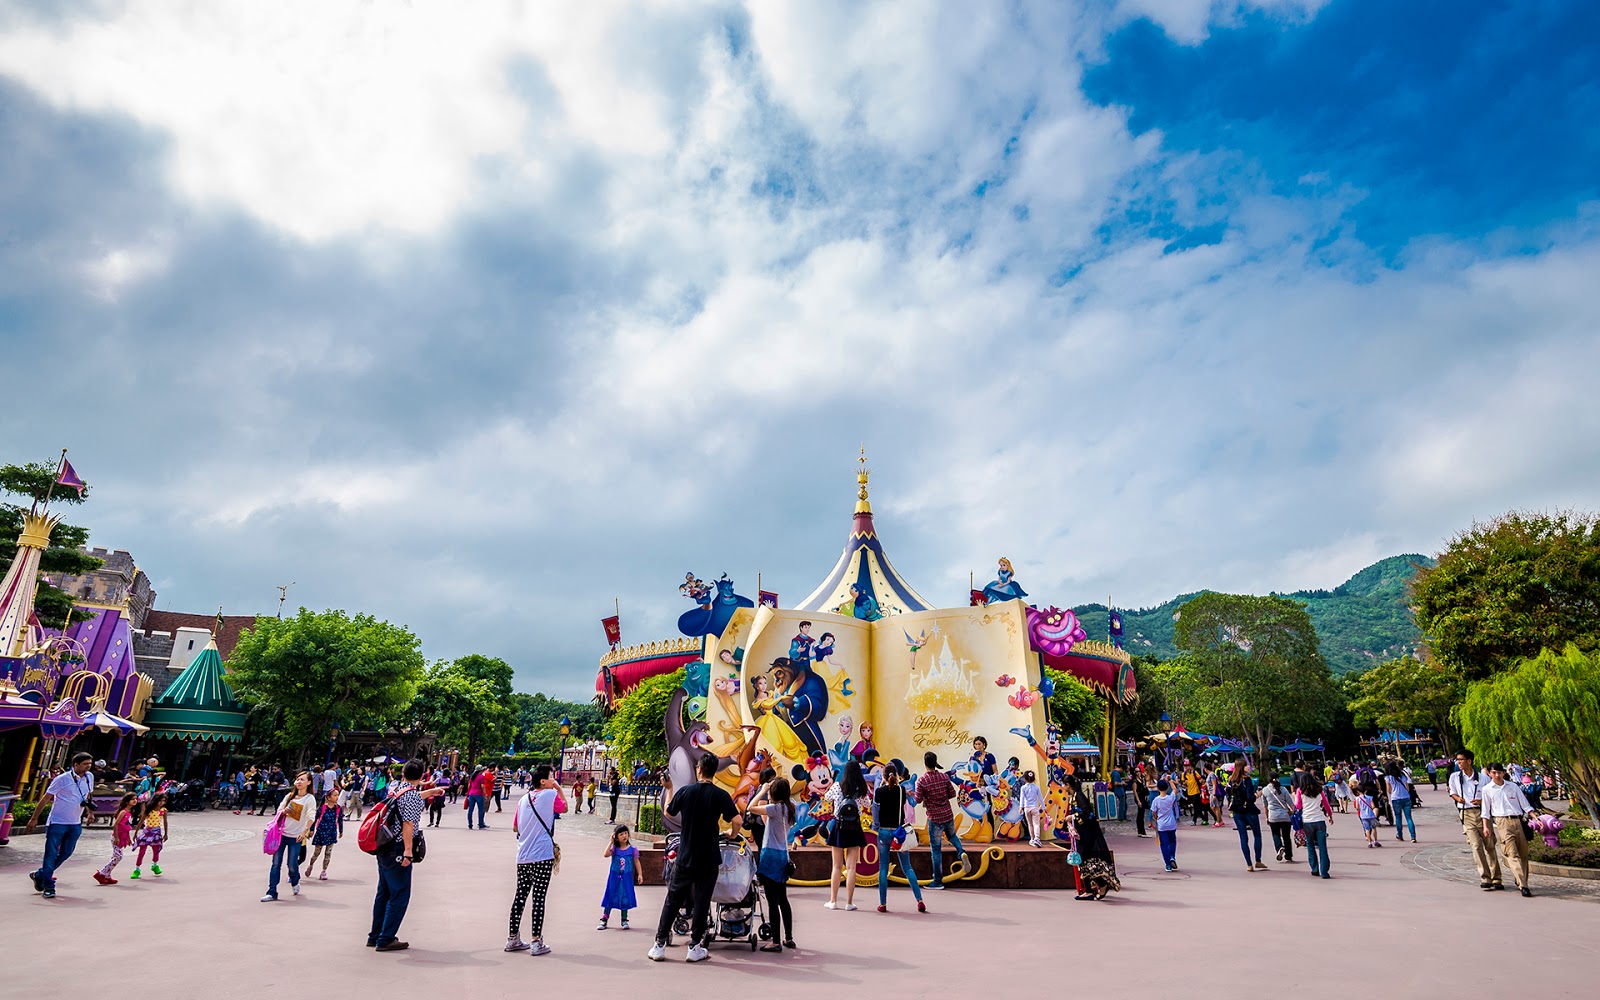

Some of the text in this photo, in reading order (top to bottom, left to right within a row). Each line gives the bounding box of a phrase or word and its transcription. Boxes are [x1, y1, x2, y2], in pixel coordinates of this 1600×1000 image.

[913, 714, 957, 733] Happily
[912, 729, 974, 749] Ever Afte
